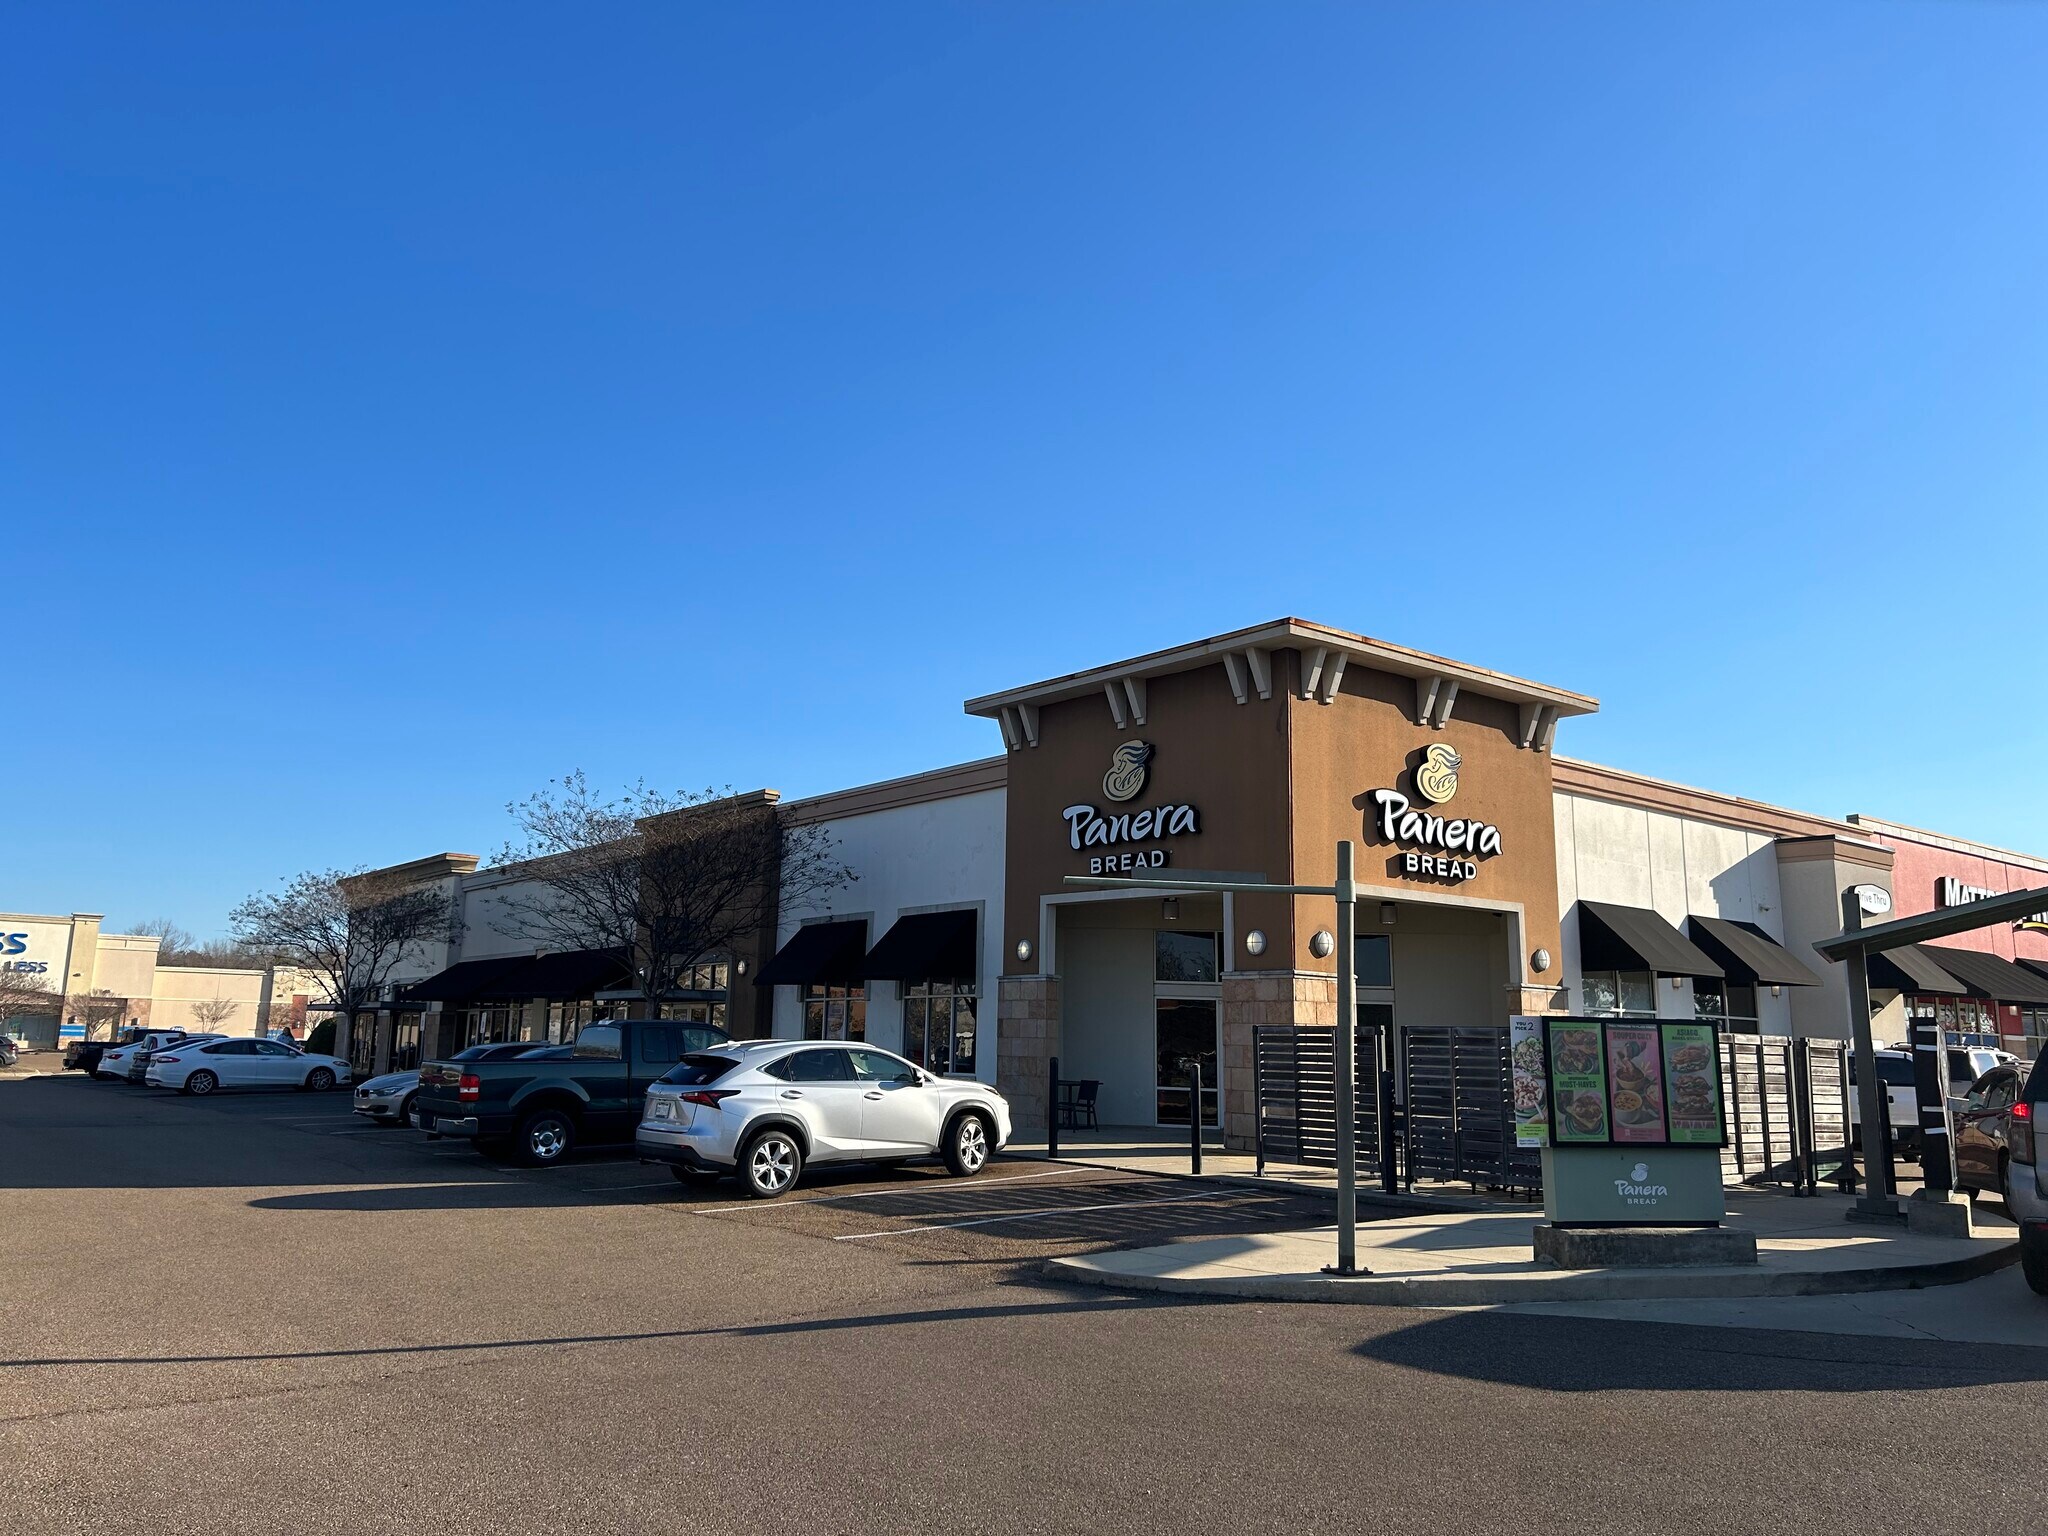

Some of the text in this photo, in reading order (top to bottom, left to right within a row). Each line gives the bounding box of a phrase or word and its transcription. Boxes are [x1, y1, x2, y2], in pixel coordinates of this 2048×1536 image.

[1063, 805, 1197, 849] Panera
[1375, 789, 1503, 855] Panera
[1090, 850, 1164, 874] BREAD
[1406, 853, 1477, 880] BREAD
[1873, 893, 1887, 906] Thru
[1527, 1021, 1534, 1031] 2
[1614, 1180, 1668, 1196] Panera
